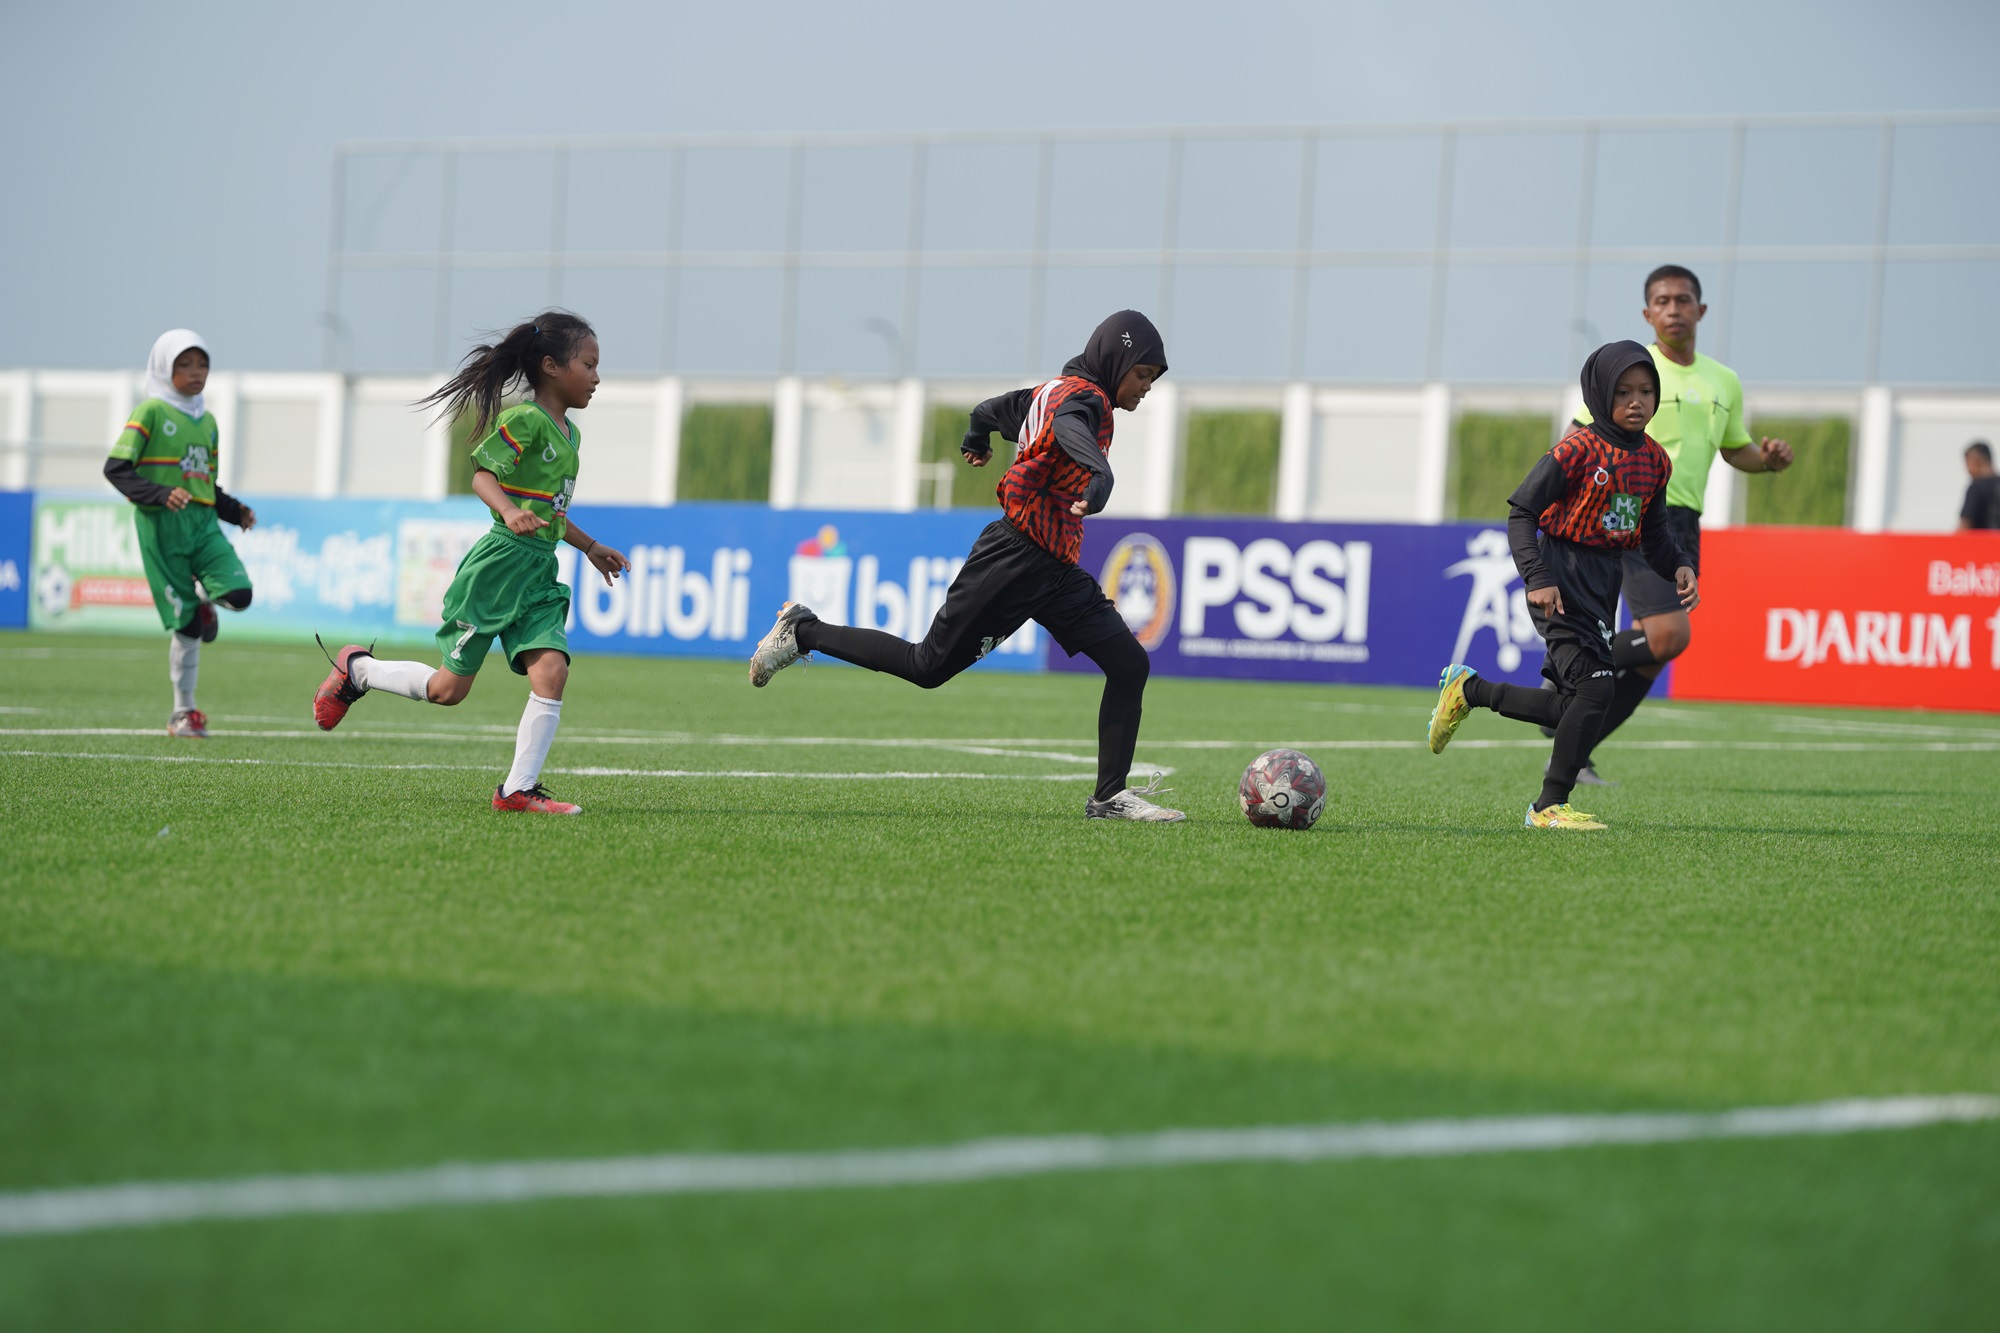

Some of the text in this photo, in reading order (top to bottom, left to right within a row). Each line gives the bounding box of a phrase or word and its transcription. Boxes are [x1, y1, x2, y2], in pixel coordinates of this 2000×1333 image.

[578, 543, 753, 641] blibli
[1179, 535, 1374, 644] PSSI
[1928, 559, 2000, 597] Bakti
[455, 619, 479, 659] 7
[1764, 607, 1972, 669] DJARUM
